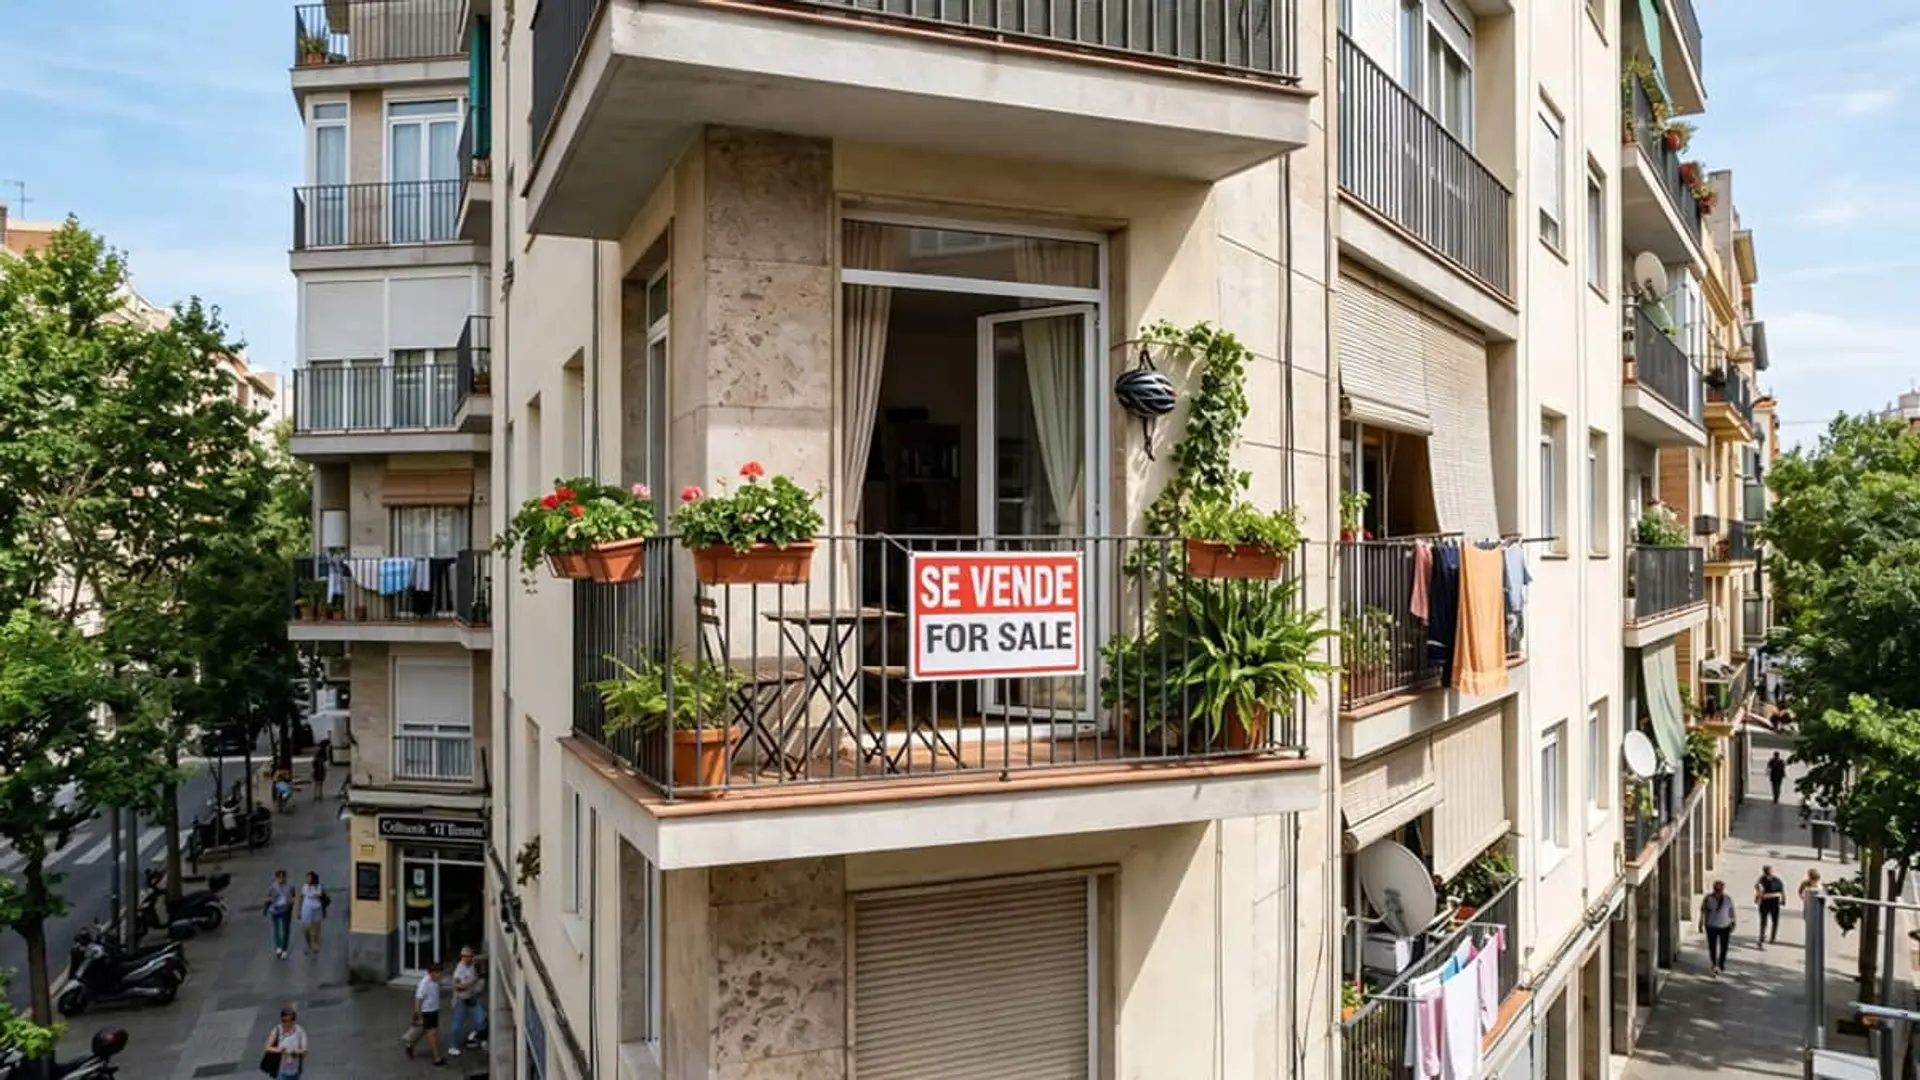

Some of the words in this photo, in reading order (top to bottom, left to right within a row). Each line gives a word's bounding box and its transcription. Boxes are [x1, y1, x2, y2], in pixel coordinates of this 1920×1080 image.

[921, 564, 962, 608] SE
[970, 564, 1073, 608] VENDE
[926, 622, 989, 654] FOR
[999, 620, 1073, 652] SALE
